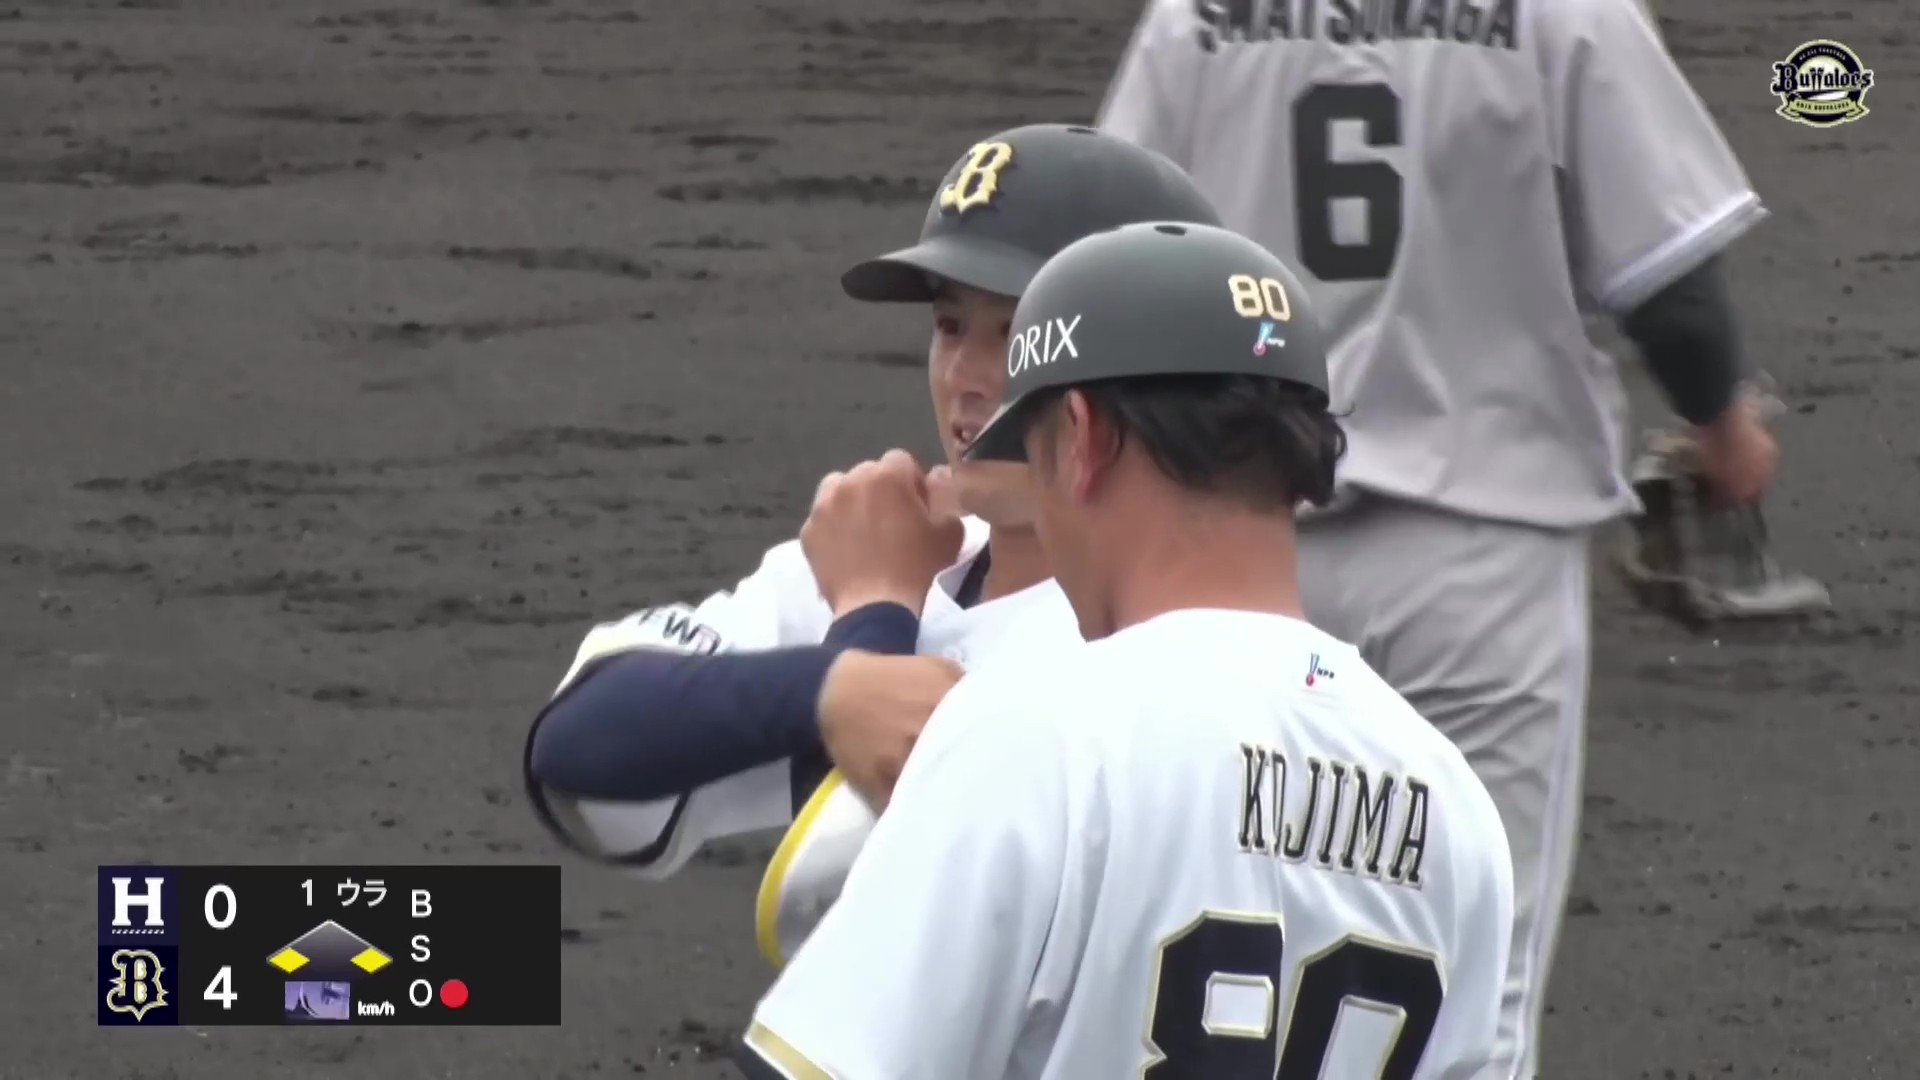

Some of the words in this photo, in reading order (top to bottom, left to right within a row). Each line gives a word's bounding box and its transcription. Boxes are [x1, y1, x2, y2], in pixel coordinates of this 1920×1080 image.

[940, 142, 1012, 214] B
[1291, 82, 1404, 282] 6
[1228, 274, 1291, 321] 80
[1008, 314, 1082, 378] ORIX
[1237, 743, 1429, 889] KOJIMA
